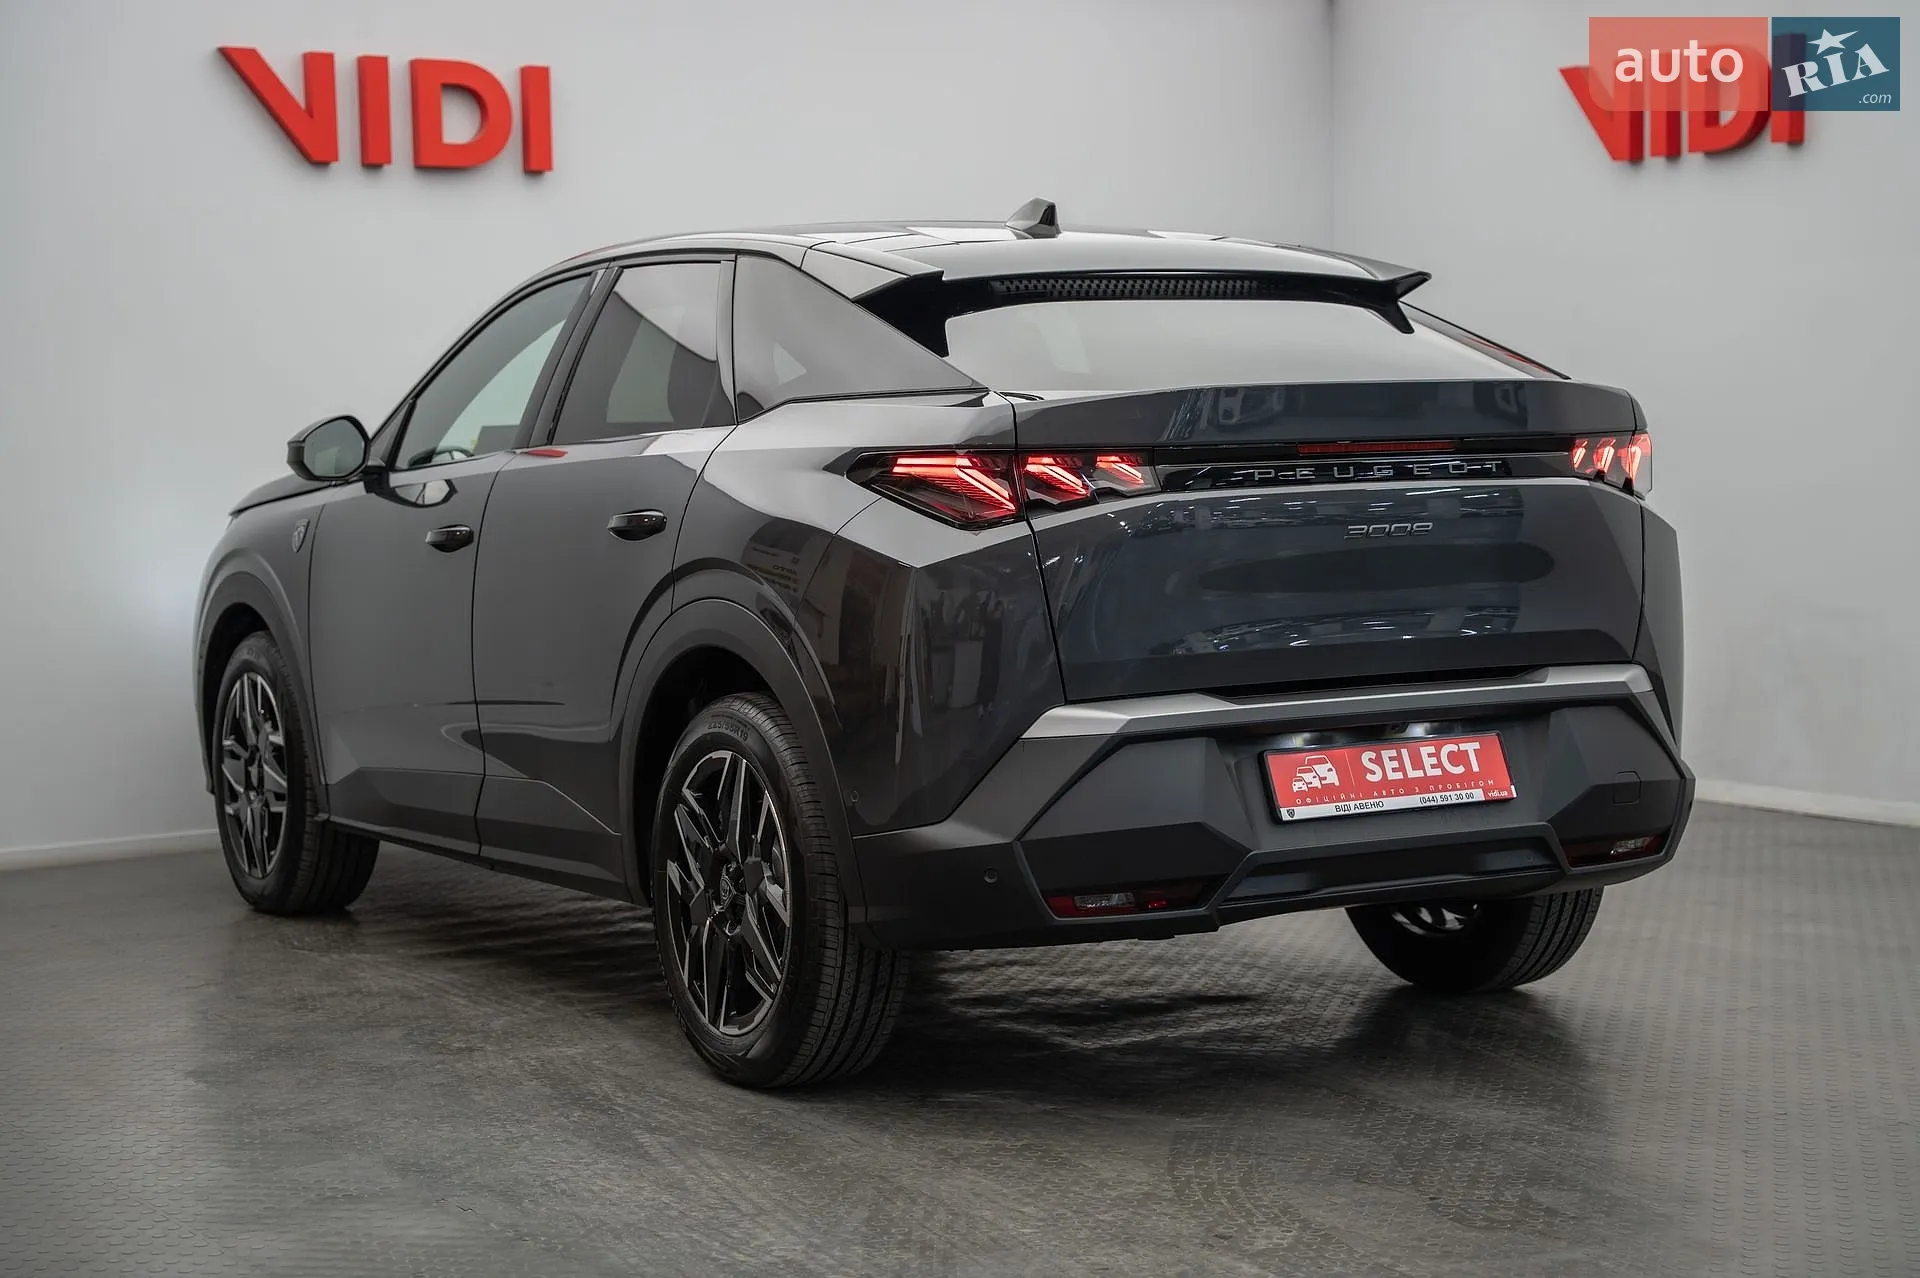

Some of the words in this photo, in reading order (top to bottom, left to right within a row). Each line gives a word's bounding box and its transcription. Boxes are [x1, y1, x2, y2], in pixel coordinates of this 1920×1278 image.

[217, 45, 553, 173] VIDI
[1558, 33, 1806, 162] VIDI
[1254, 460, 1502, 481] PEUGEOT
[1344, 522, 1433, 539] 3008
[1361, 742, 1481, 783] SELECT
[1295, 792, 1364, 805] ОФІЦІЙНІ
[1373, 788, 1405, 797] АВТО
[1429, 780, 1494, 792] ПРОБІГОМ
[1334, 803, 1352, 813] ВІДІ
[1353, 800, 1385, 811] АВЕНЮ
[1419, 794, 1439, 805] (044)
[1440, 793, 1452, 803] 591
[1454, 792, 1464, 802] 30
[1464, 791, 1475, 801] 00
[1487, 789, 1508, 798] vidi.ua
